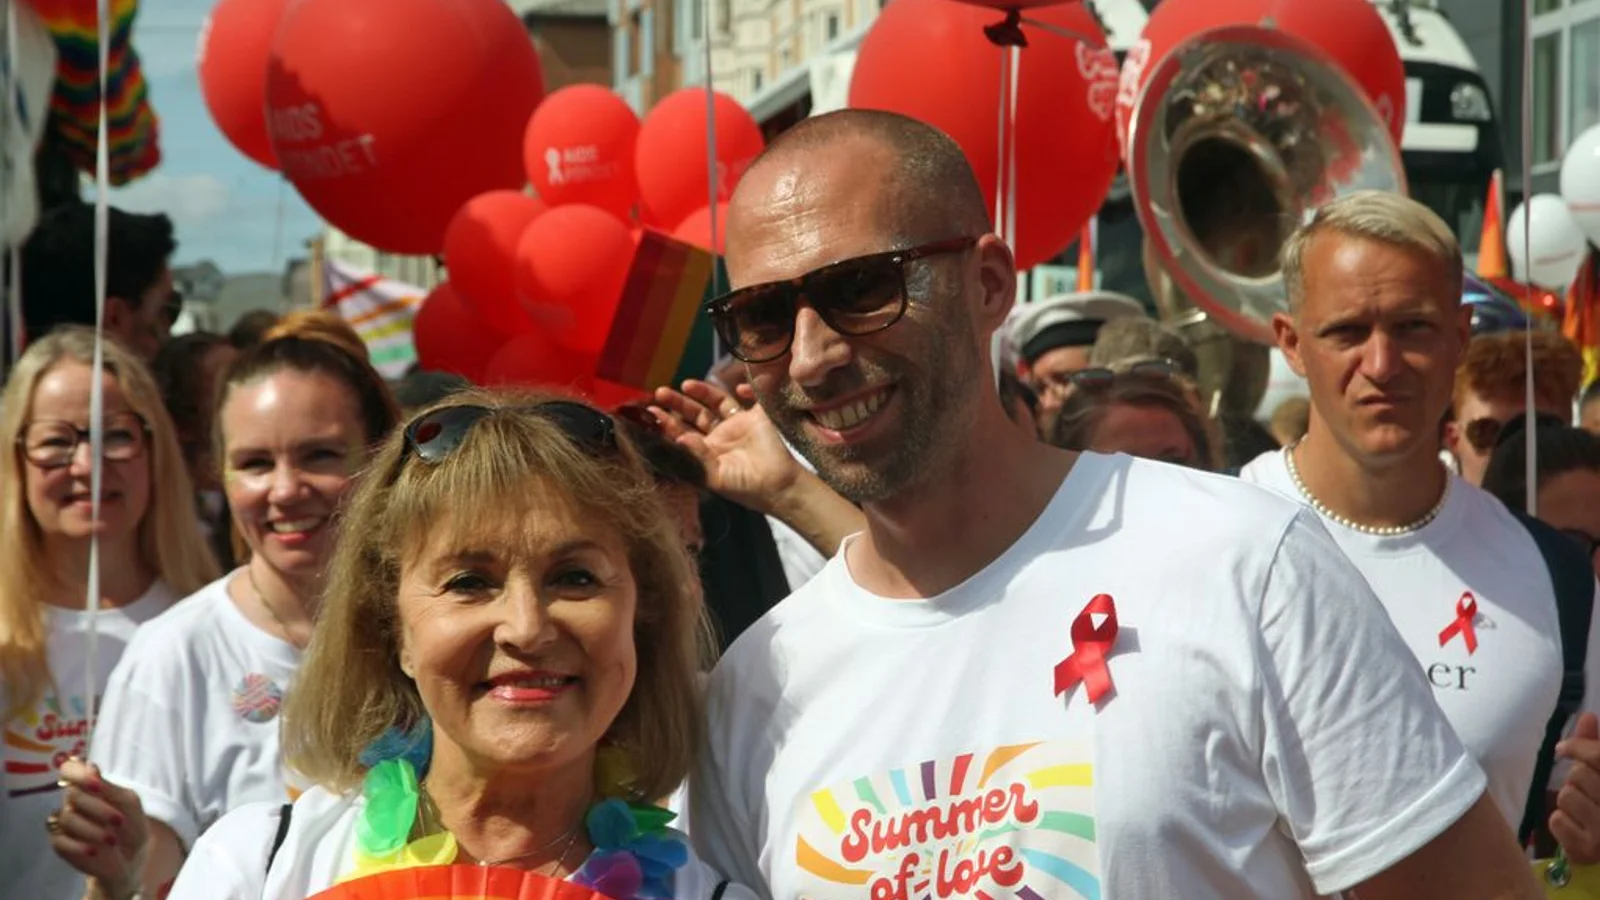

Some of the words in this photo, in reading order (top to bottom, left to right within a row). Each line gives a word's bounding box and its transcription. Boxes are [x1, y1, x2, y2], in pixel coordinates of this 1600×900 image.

[841, 783, 1038, 863] Summer
[871, 853, 919, 900] of
[937, 845, 1024, 898] love
